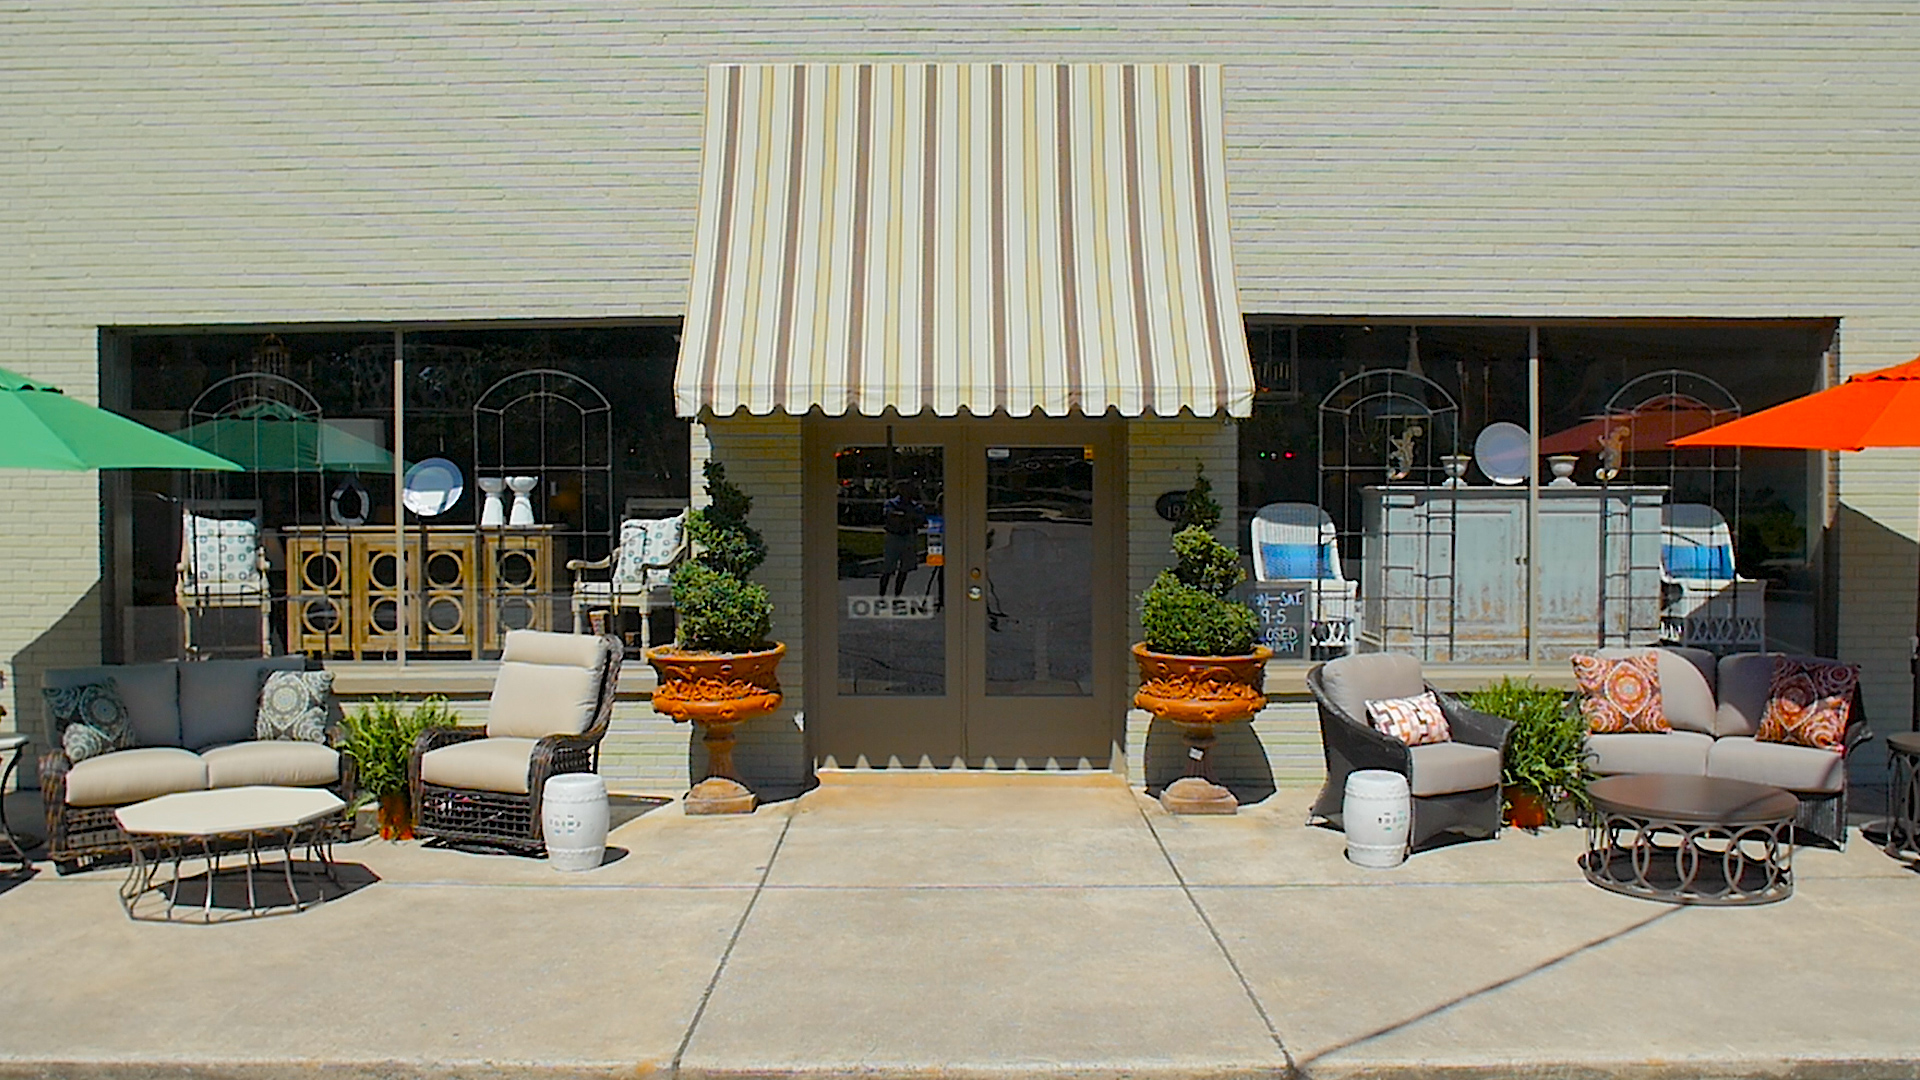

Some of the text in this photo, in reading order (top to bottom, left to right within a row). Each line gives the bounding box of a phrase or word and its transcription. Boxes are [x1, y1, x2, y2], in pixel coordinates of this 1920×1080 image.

[852, 600, 929, 616] OPEN
[1260, 608, 1287, 625] 9-5
[1265, 627, 1297, 641] OSED
